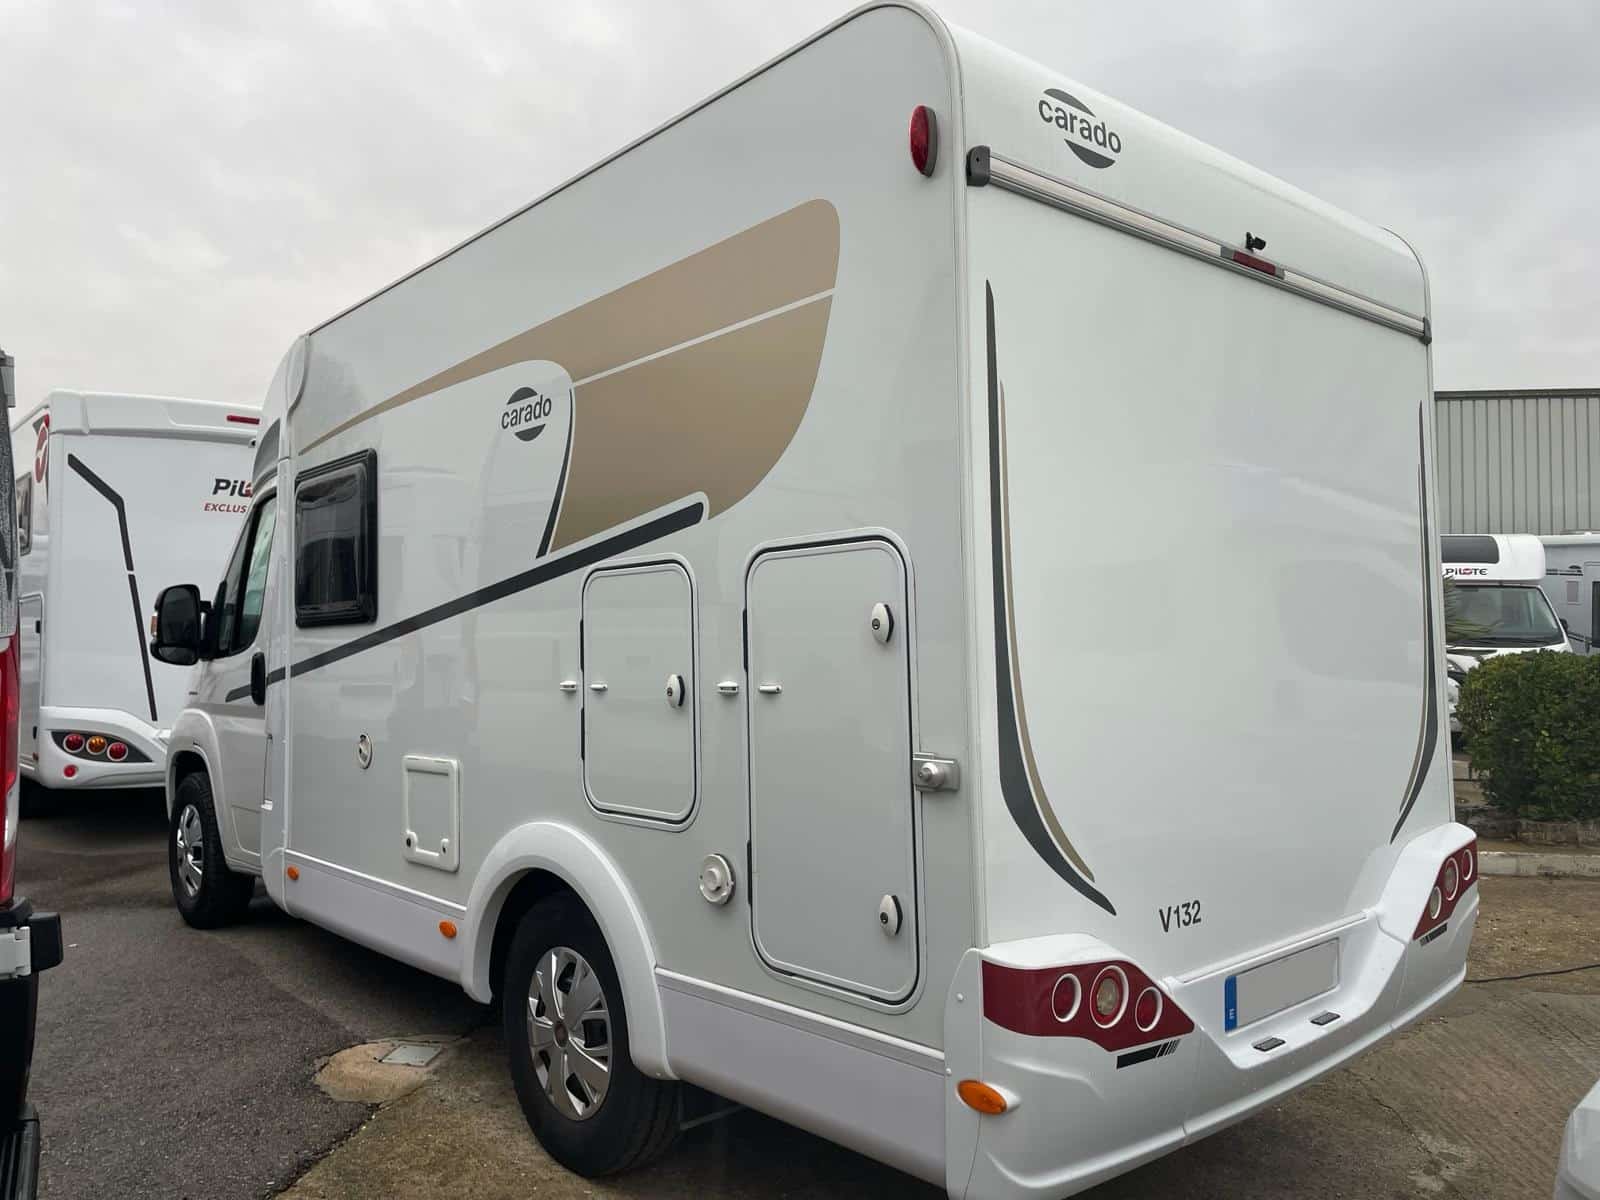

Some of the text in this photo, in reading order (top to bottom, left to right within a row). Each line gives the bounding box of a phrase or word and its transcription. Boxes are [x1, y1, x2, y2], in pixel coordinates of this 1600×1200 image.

[1039, 100, 1121, 153] carado
[501, 394, 551, 429] carado
[1159, 900, 1201, 932] V132
